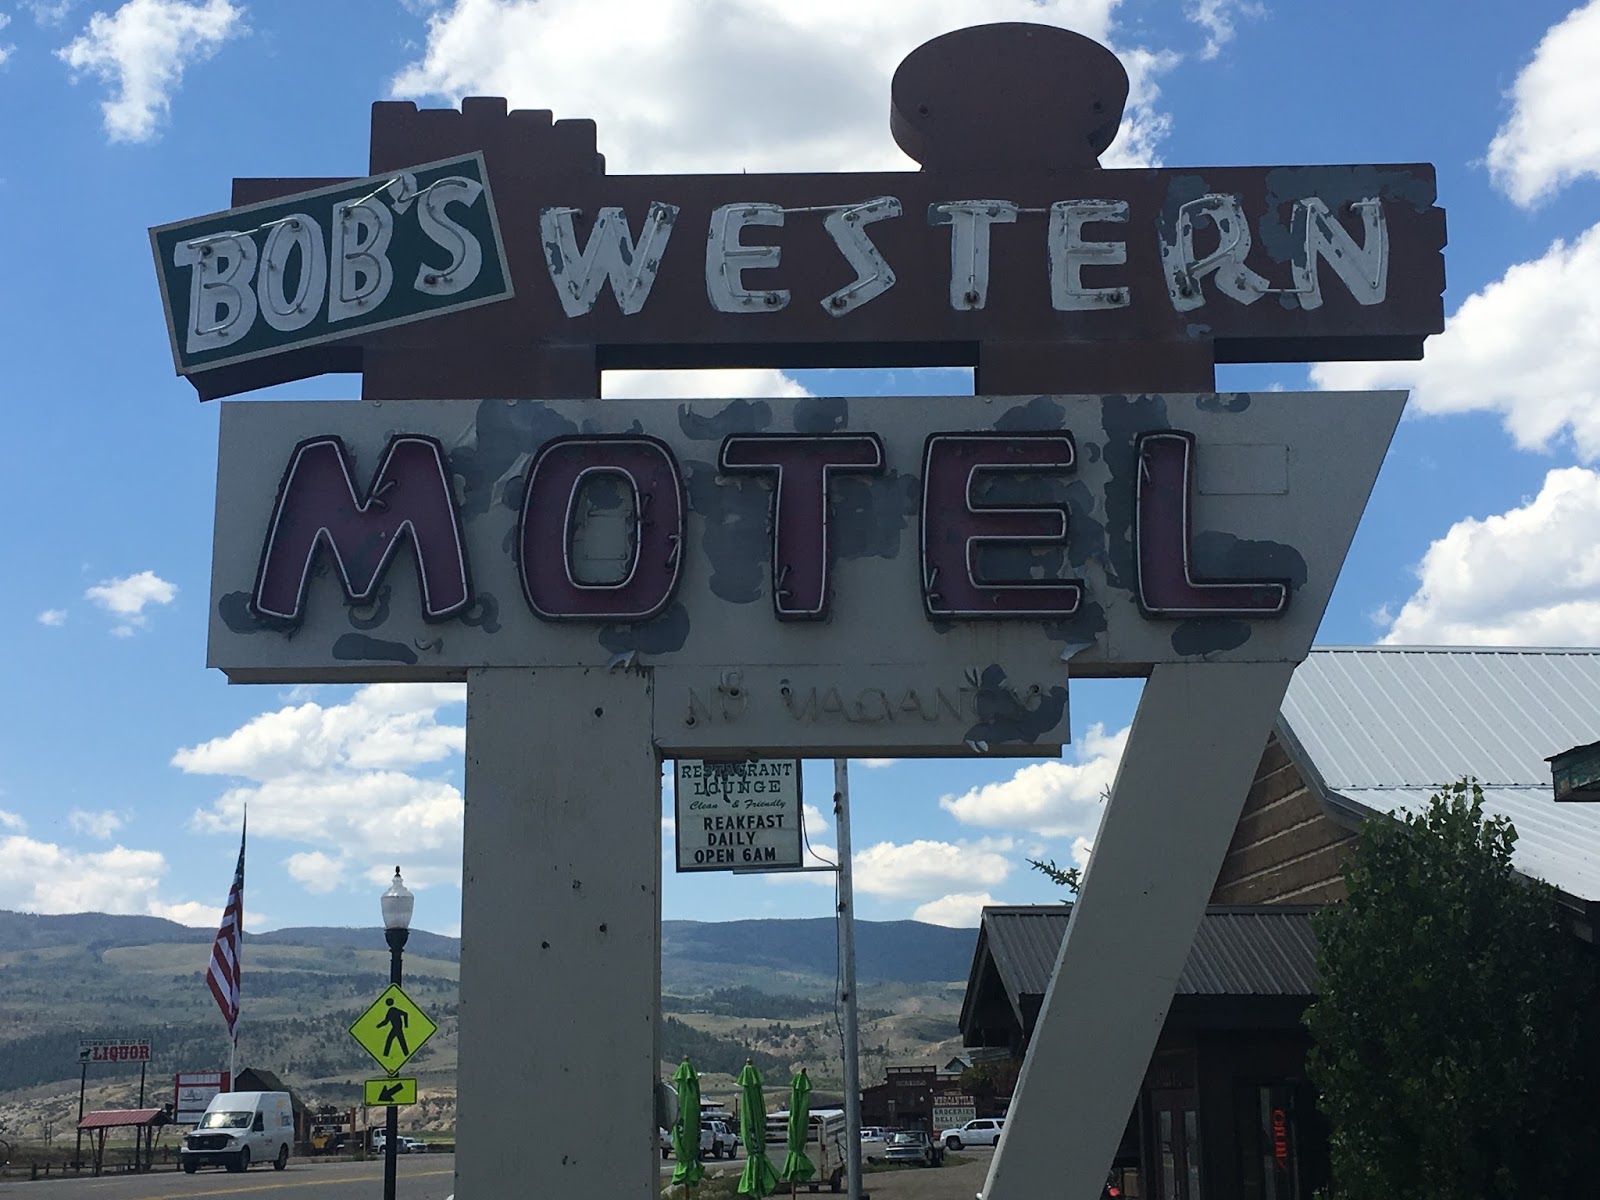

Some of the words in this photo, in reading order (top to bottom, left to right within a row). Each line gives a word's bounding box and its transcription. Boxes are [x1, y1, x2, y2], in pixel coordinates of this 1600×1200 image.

[173, 172, 484, 354] BOB'S
[539, 193, 1391, 318] WESTERN
[252, 430, 1294, 623] MOTEL
[694, 780, 781, 796] LOUNGE
[689, 801, 718, 810] Clean
[732, 799, 739, 809] &
[744, 799, 786, 809] Friendly
[703, 814, 784, 831] REAKFAST
[708, 831, 756, 846] DAILY
[694, 849, 735, 864] OPEN
[743, 847, 776, 861] 6AM
[93, 1046, 150, 1061] LIQUOR
